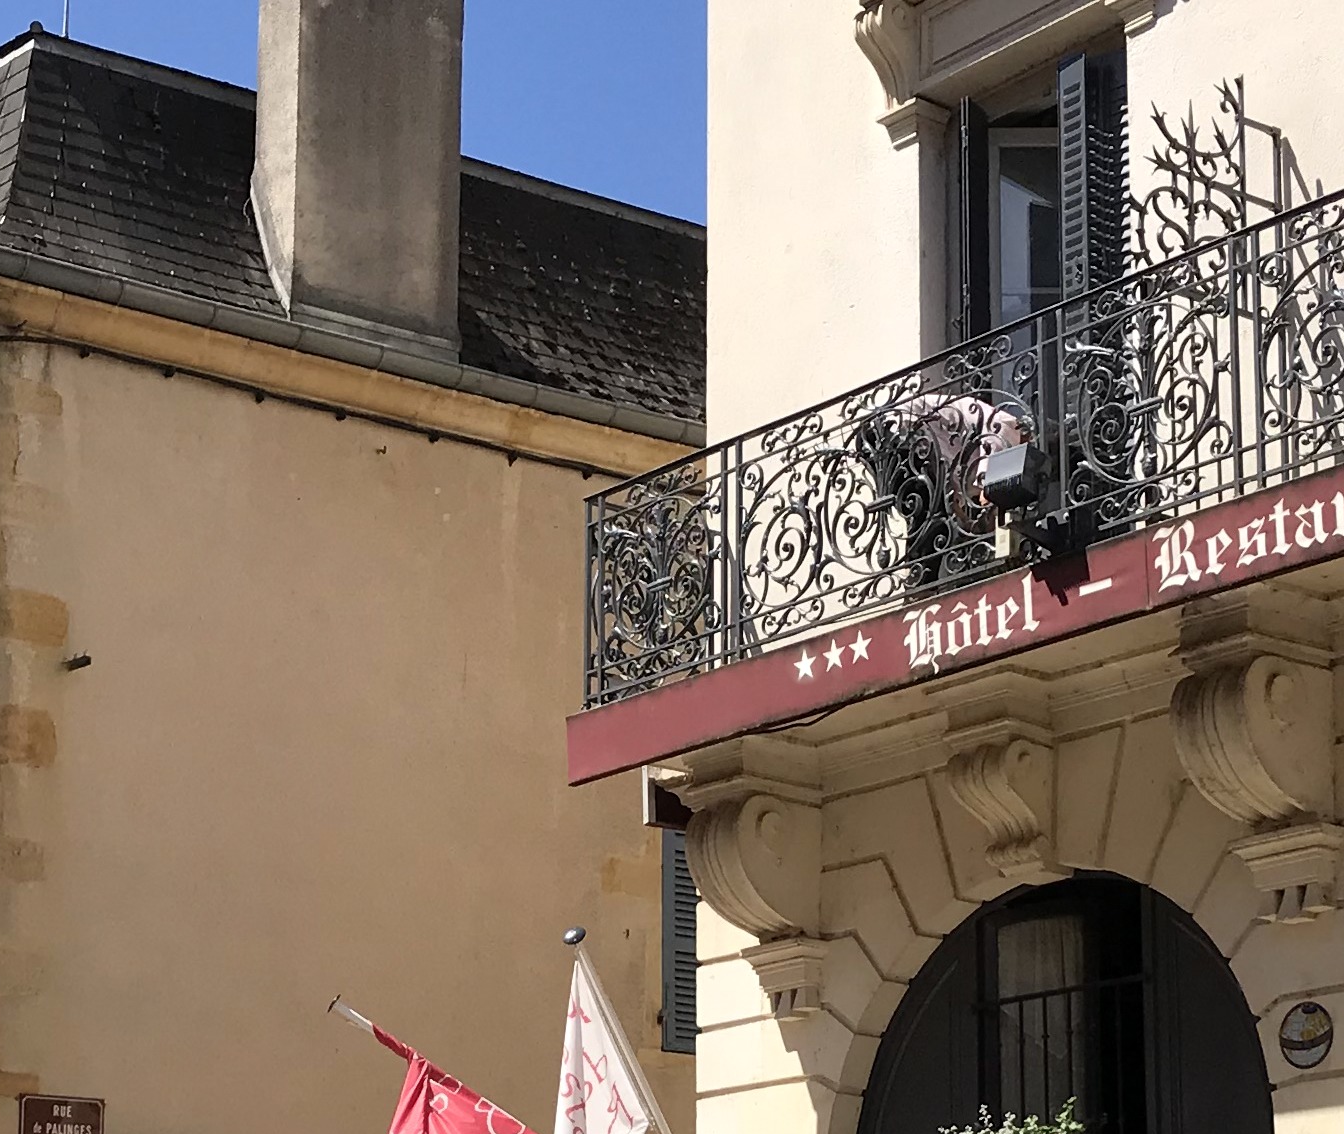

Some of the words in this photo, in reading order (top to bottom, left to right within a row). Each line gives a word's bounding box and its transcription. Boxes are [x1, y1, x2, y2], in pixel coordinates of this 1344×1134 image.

[903, 572, 1041, 673] Hôtel
[53, 1105, 73, 1118] RUE
[33, 1122, 42, 1134] de
